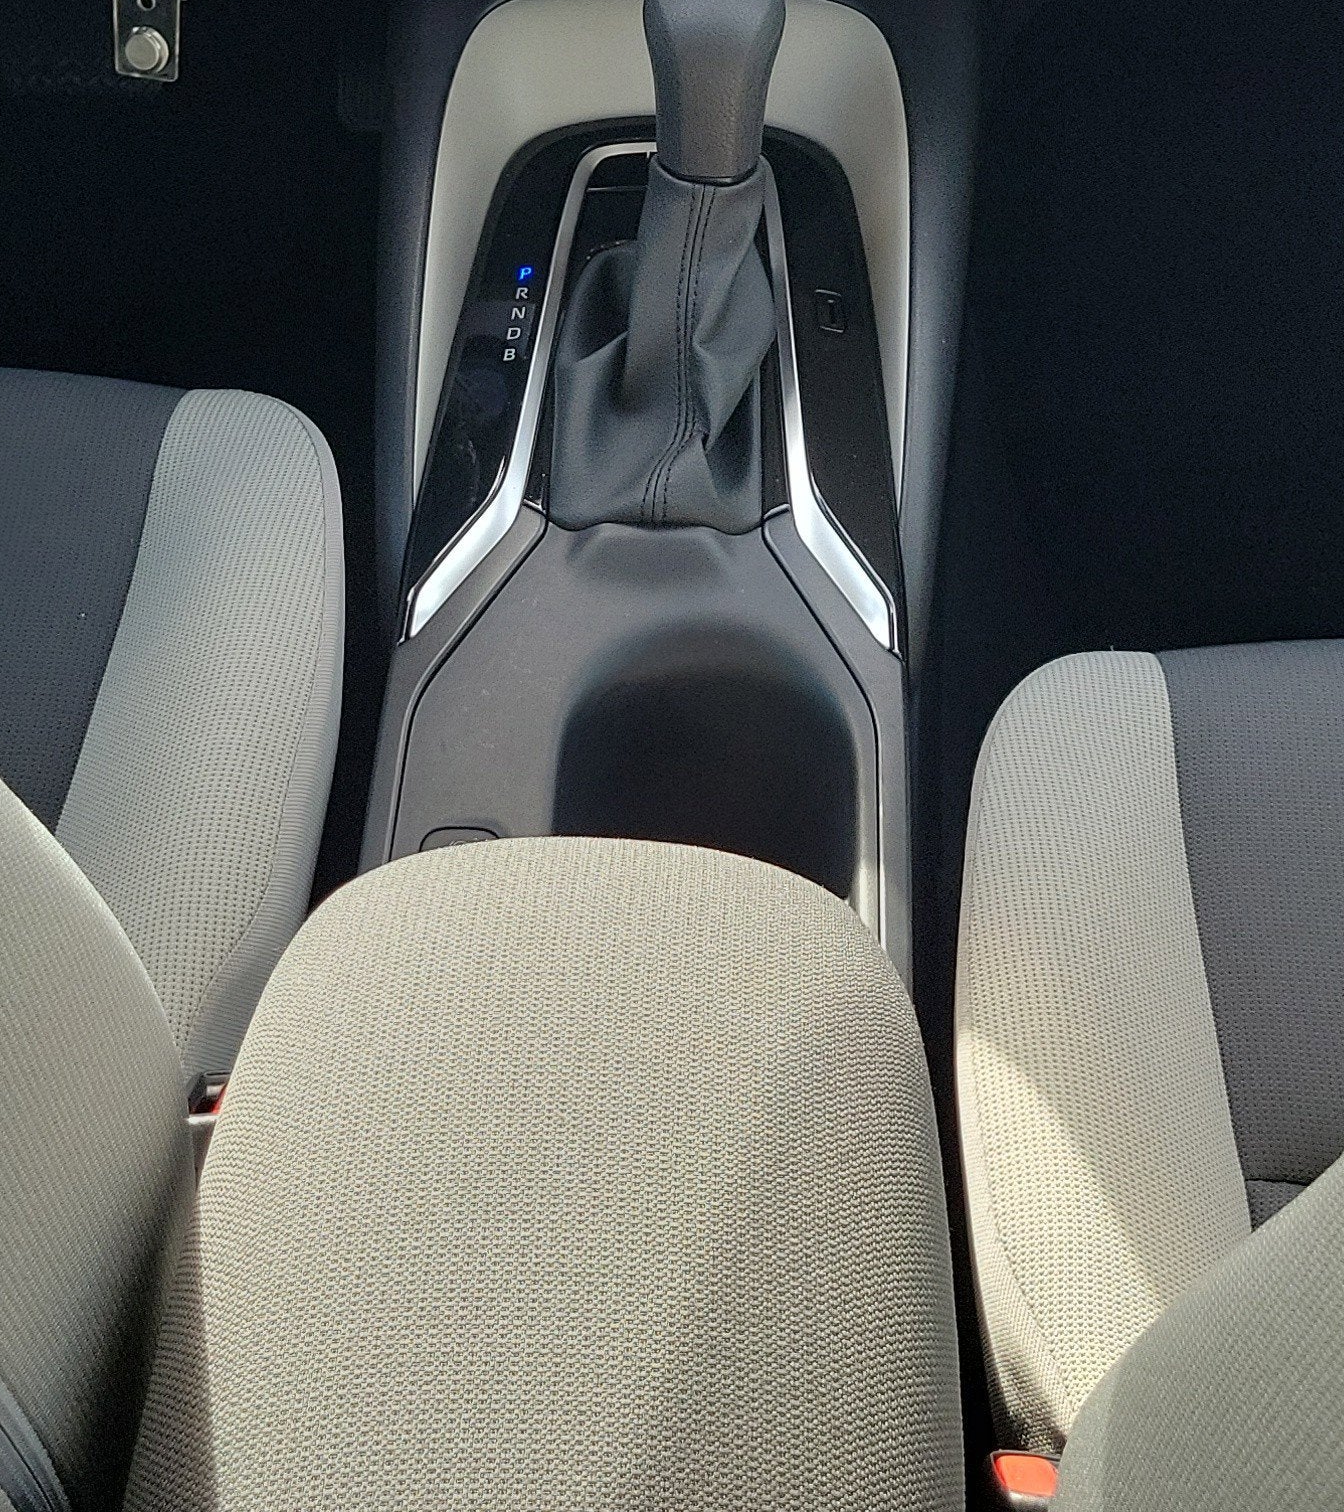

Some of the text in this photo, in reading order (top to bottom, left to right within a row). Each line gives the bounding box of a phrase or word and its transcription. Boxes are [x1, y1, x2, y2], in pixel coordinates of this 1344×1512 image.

[519, 267, 532, 280] P
[516, 287, 528, 300] R
[511, 307, 526, 320] N
[506, 327, 521, 340] D
[503, 348, 516, 361] B
